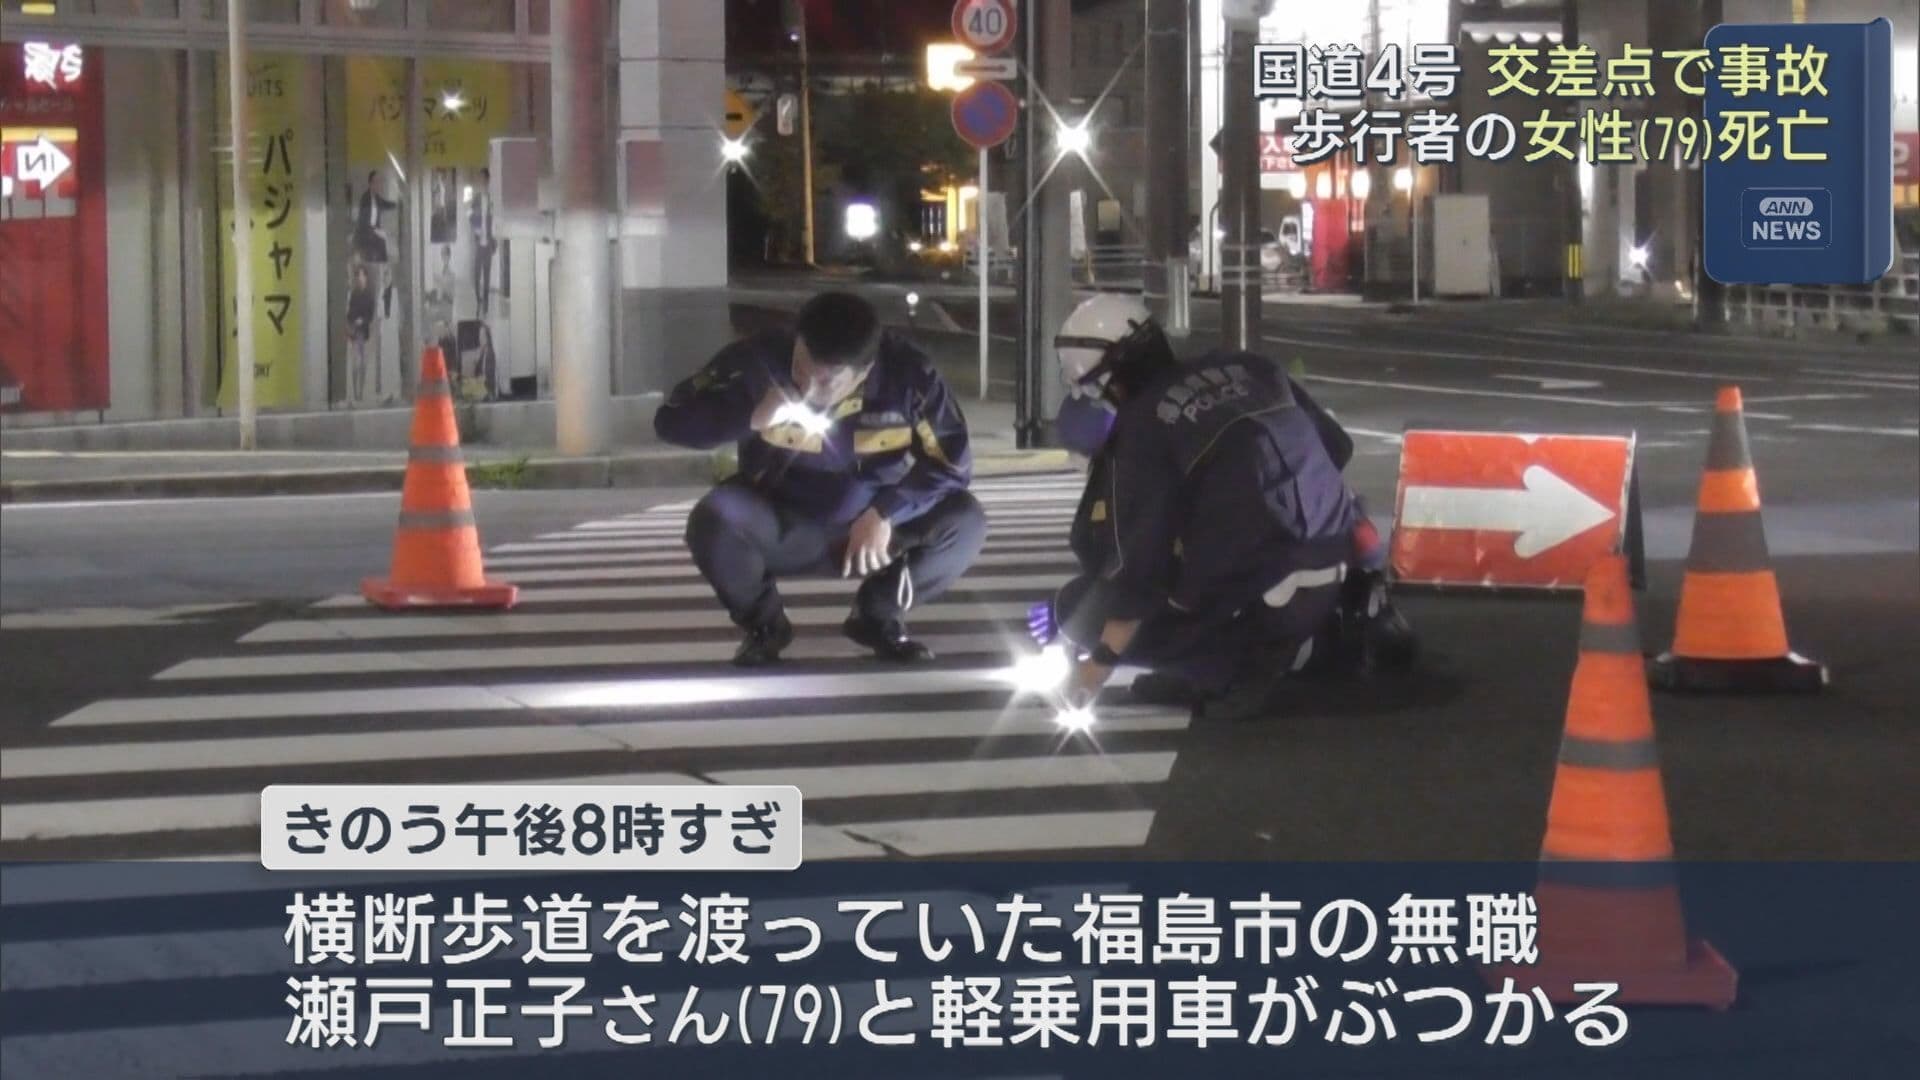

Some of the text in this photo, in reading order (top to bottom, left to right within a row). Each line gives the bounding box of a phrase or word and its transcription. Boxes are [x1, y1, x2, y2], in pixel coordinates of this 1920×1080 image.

[968, 7, 1002, 35] 40
[263, 128, 294, 335] パジャマ
